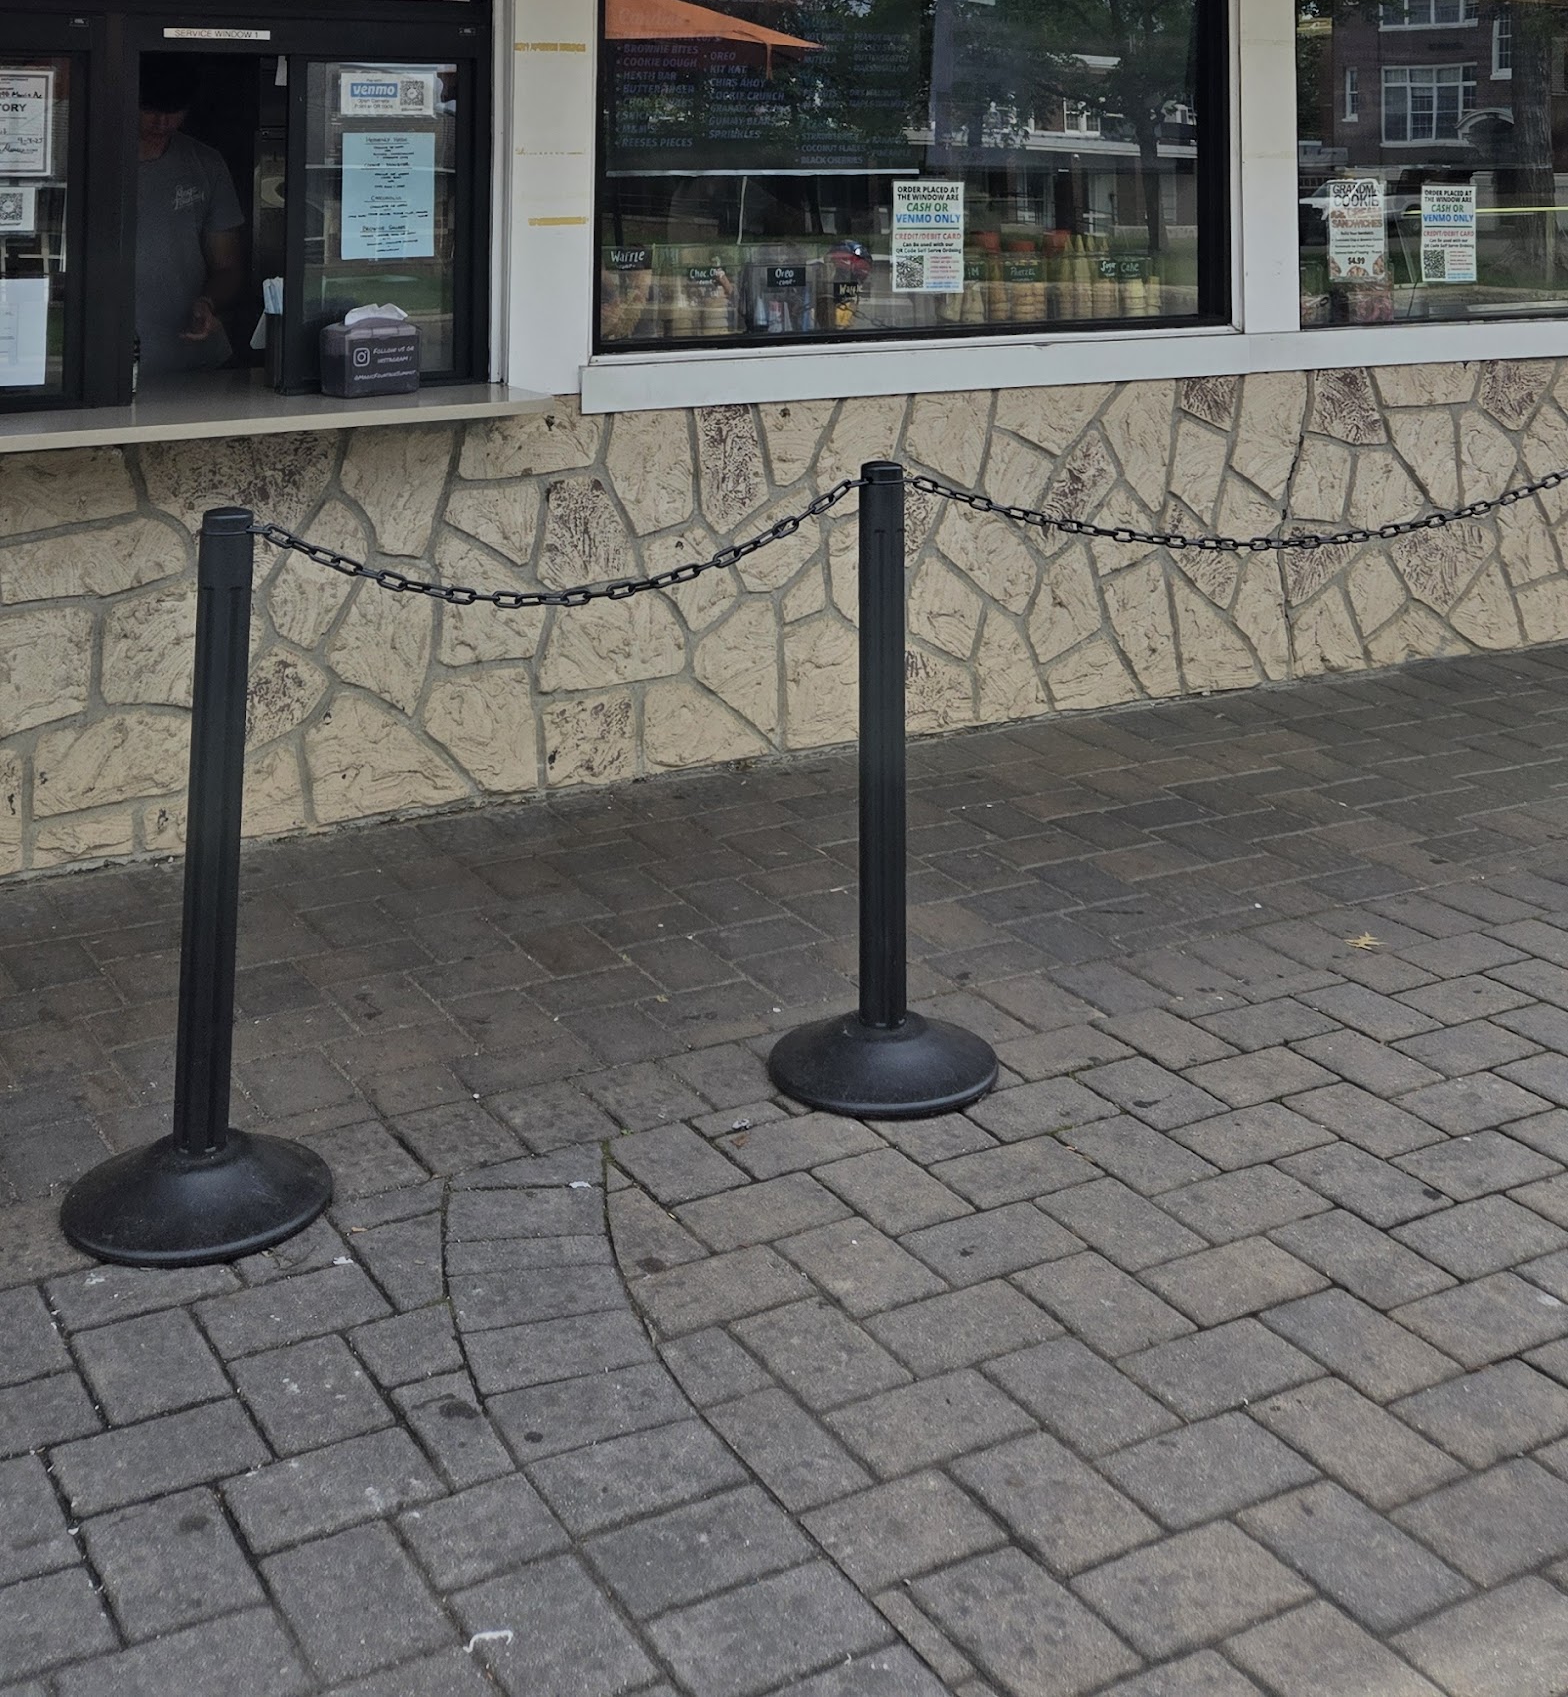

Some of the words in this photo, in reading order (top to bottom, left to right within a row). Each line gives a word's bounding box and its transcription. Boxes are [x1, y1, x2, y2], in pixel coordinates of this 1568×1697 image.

[174, 29, 212, 38] SERVICE
[214, 30, 252, 39] WINDOW
[623, 45, 670, 54] BROWNIE
[671, 46, 699, 55] BITES
[710, 52, 736, 61] OREO
[623, 58, 661, 67] COOKIE
[663, 58, 698, 67] DOUGH
[709, 65, 725, 74] KIT
[727, 65, 748, 74] KAT
[658, 72, 677, 81] BAR
[739, 79, 766, 88] AHOY
[353, 85, 395, 95] venmo
[746, 92, 785, 101] CRUNCH
[0, 103, 27, 113] ORY
[708, 130, 761, 139] SPRINKLES
[621, 137, 658, 147] REESES
[659, 137, 694, 147] PIECES
[801, 156, 826, 164] BLACK
[1334, 194, 1380, 207] COOKIE
[906, 203, 931, 212] CASH
[934, 203, 949, 212] OR
[1431, 204, 1451, 212] CASH
[1452, 204, 1464, 212] OR
[895, 214, 932, 223] VENMO
[934, 214, 961, 223] ONLY
[1423, 214, 1451, 222] VENMO
[1453, 214, 1474, 222] ONLY
[1331, 219, 1383, 228] SANDWICHES
[610, 250, 645, 263] Waffle
[775, 268, 794, 279] Oreo
[373, 347, 397, 355] FOLLOW
